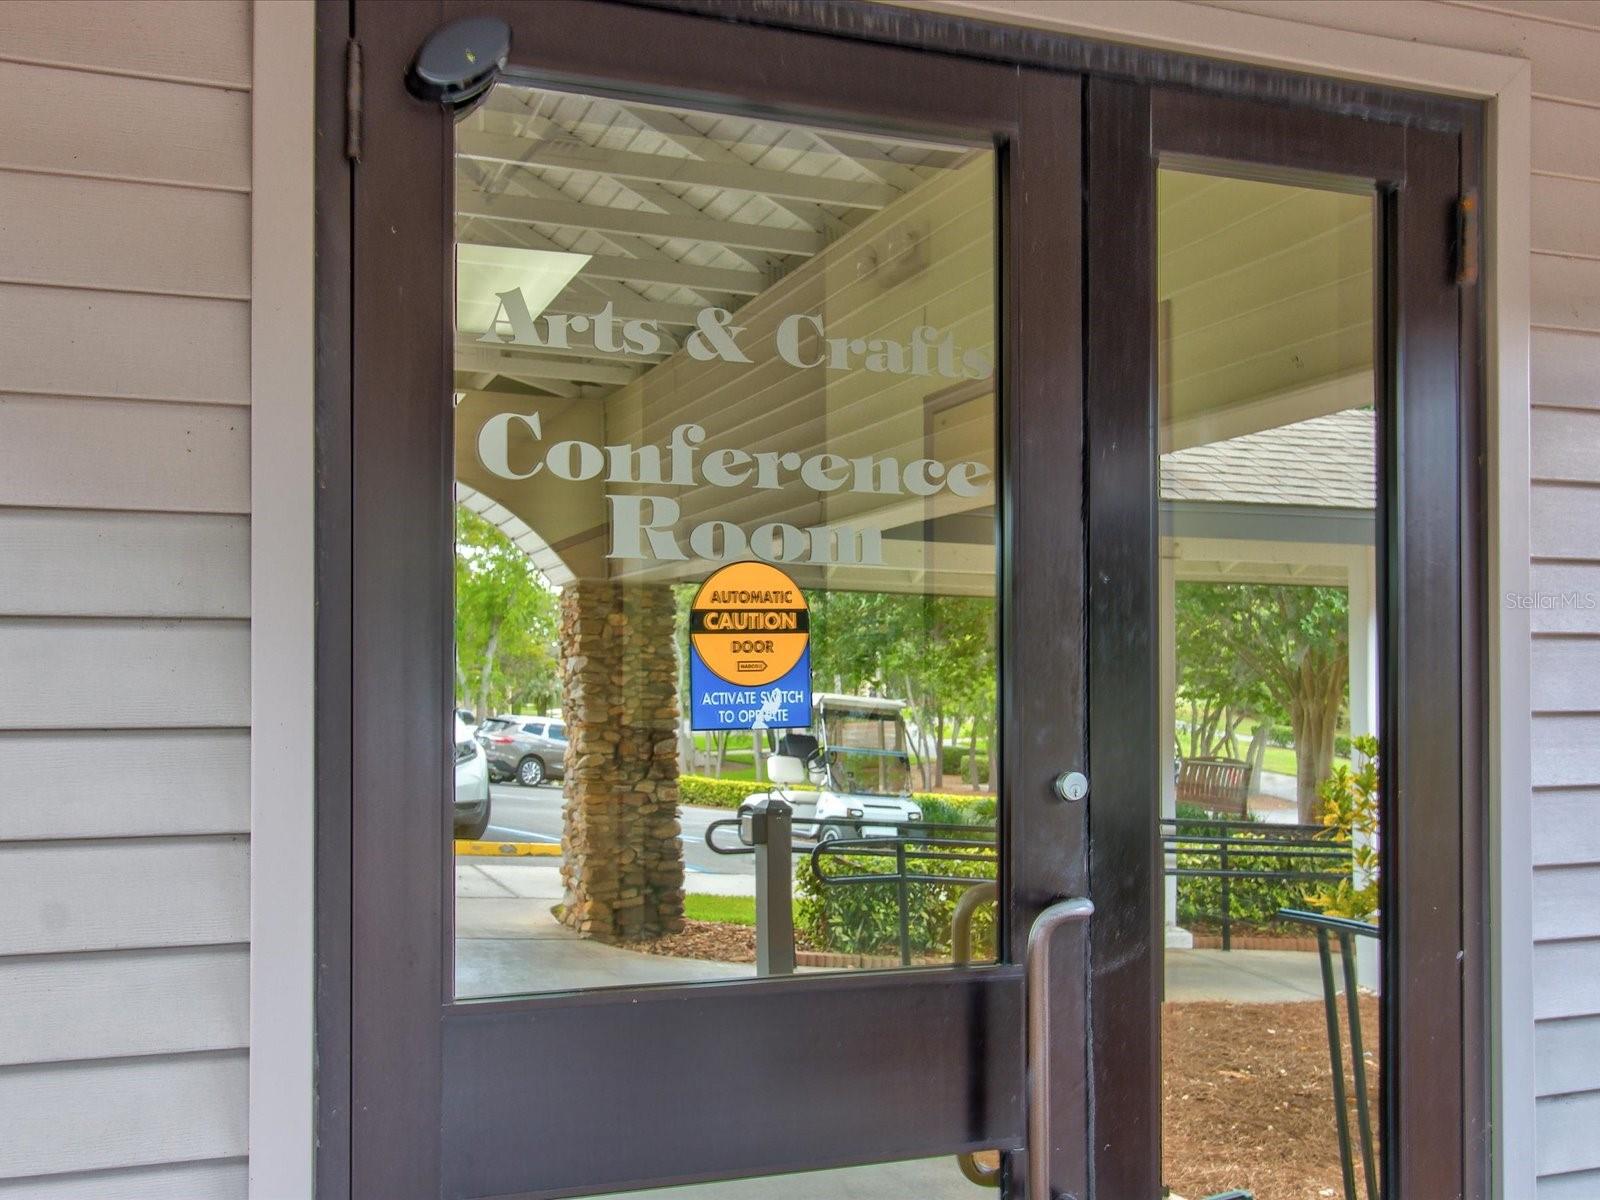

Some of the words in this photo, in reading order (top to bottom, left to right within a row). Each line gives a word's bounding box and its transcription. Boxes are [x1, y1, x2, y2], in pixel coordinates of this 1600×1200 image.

[475, 286, 662, 357] Arts
[686, 307, 755, 364] &
[775, 313, 994, 382] Crafts
[477, 410, 993, 498] Conference
[604, 494, 884, 566] Room
[710, 591, 793, 604] AUTOMATIC
[703, 611, 798, 631] CAUTION
[731, 640, 775, 654] DOOR
[702, 692, 757, 705] ACTIVATE
[760, 690, 804, 704] SWTCH
[718, 711, 735, 723] TO
